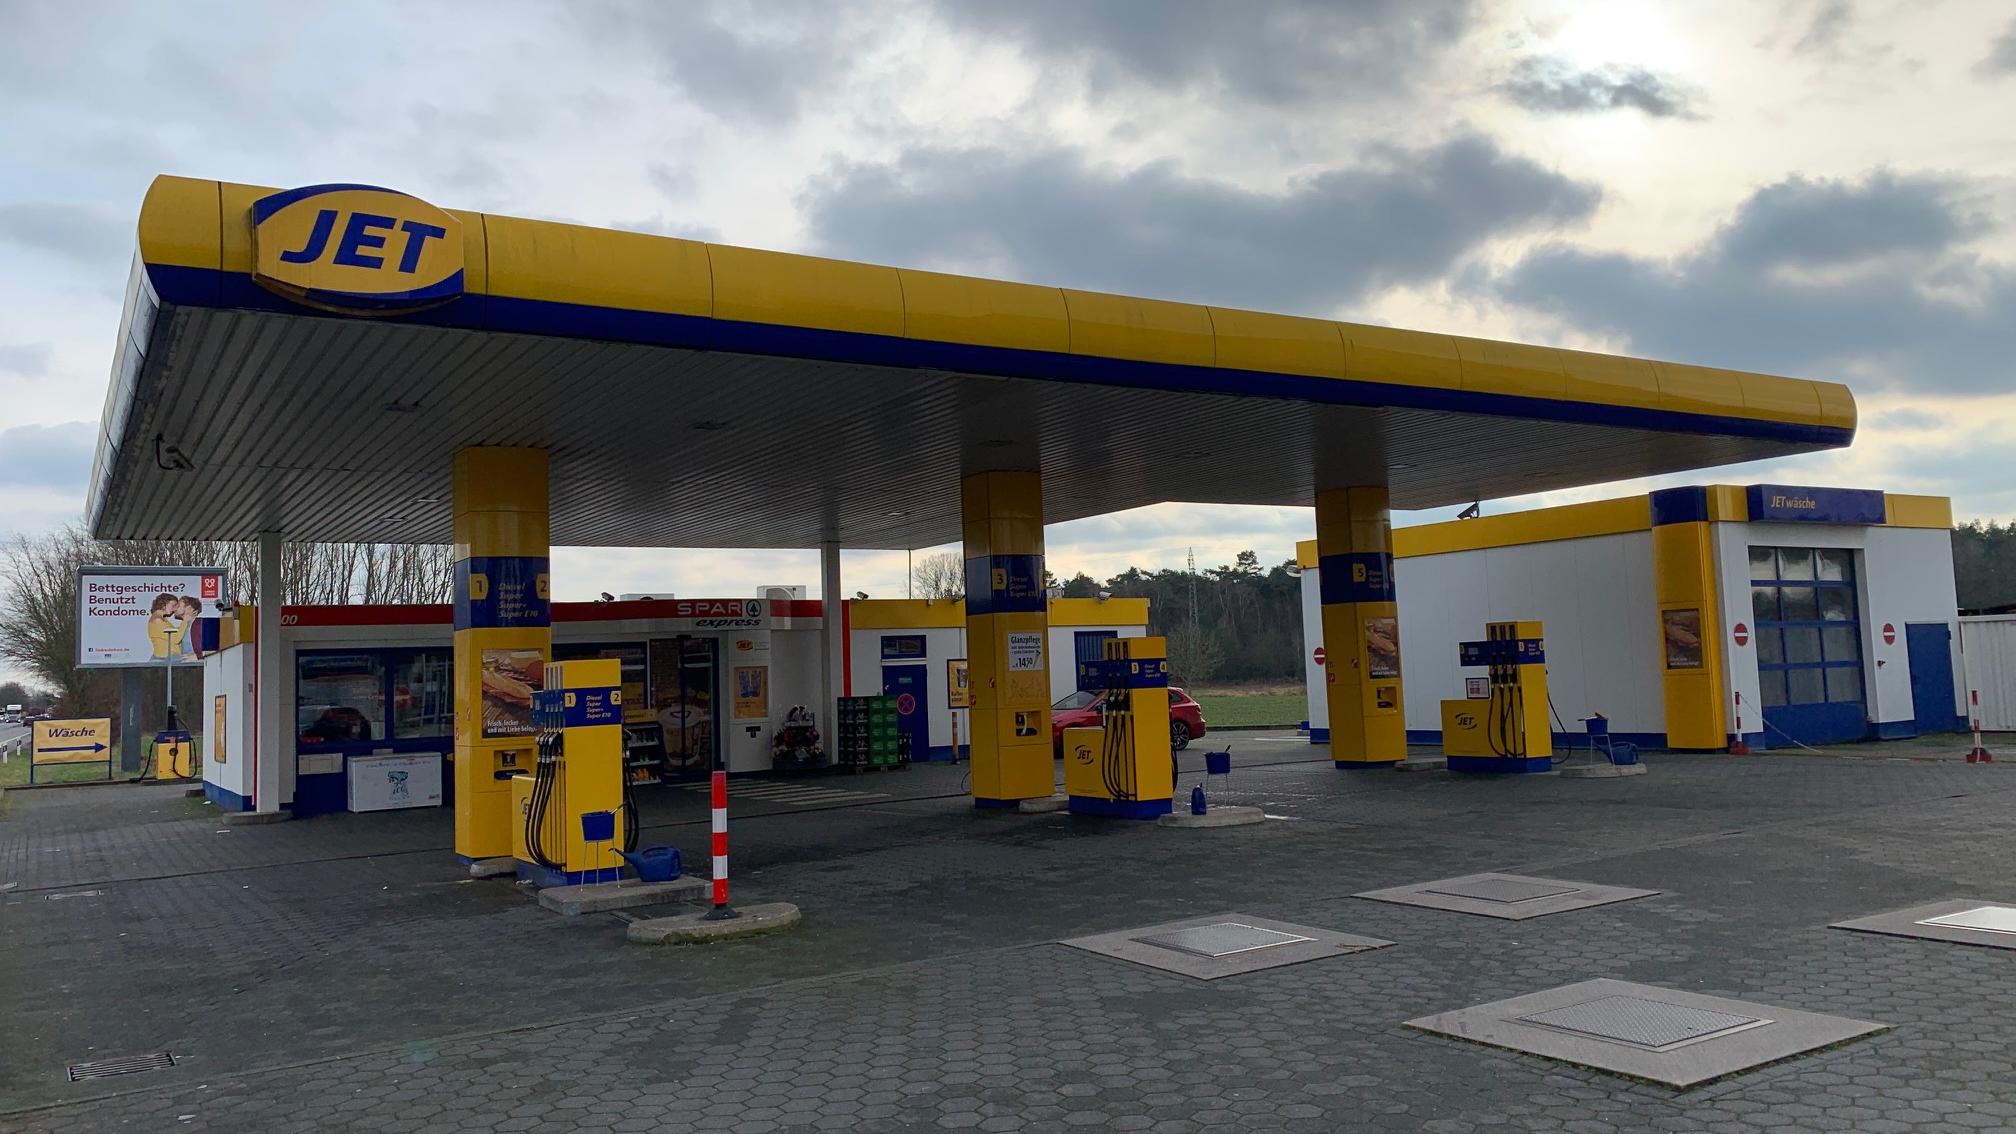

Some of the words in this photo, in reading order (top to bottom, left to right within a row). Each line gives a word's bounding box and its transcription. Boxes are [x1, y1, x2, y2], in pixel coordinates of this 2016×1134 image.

[279, 209, 447, 274] JET
[88, 583, 186, 595] Bettgeschichte?
[88, 595, 136, 605] Benutzt
[498, 591, 524, 601] Super
[88, 607, 150, 617] Kondome.
[498, 609, 523, 619] Super
[524, 609, 540, 618] E10
[677, 602, 742, 616] SPAR
[696, 619, 762, 629] express
[1457, 716, 1475, 726] JET
[48, 726, 96, 738] Wäsche
[507, 725, 520, 733] Liebe
[1077, 750, 1092, 760] JET
